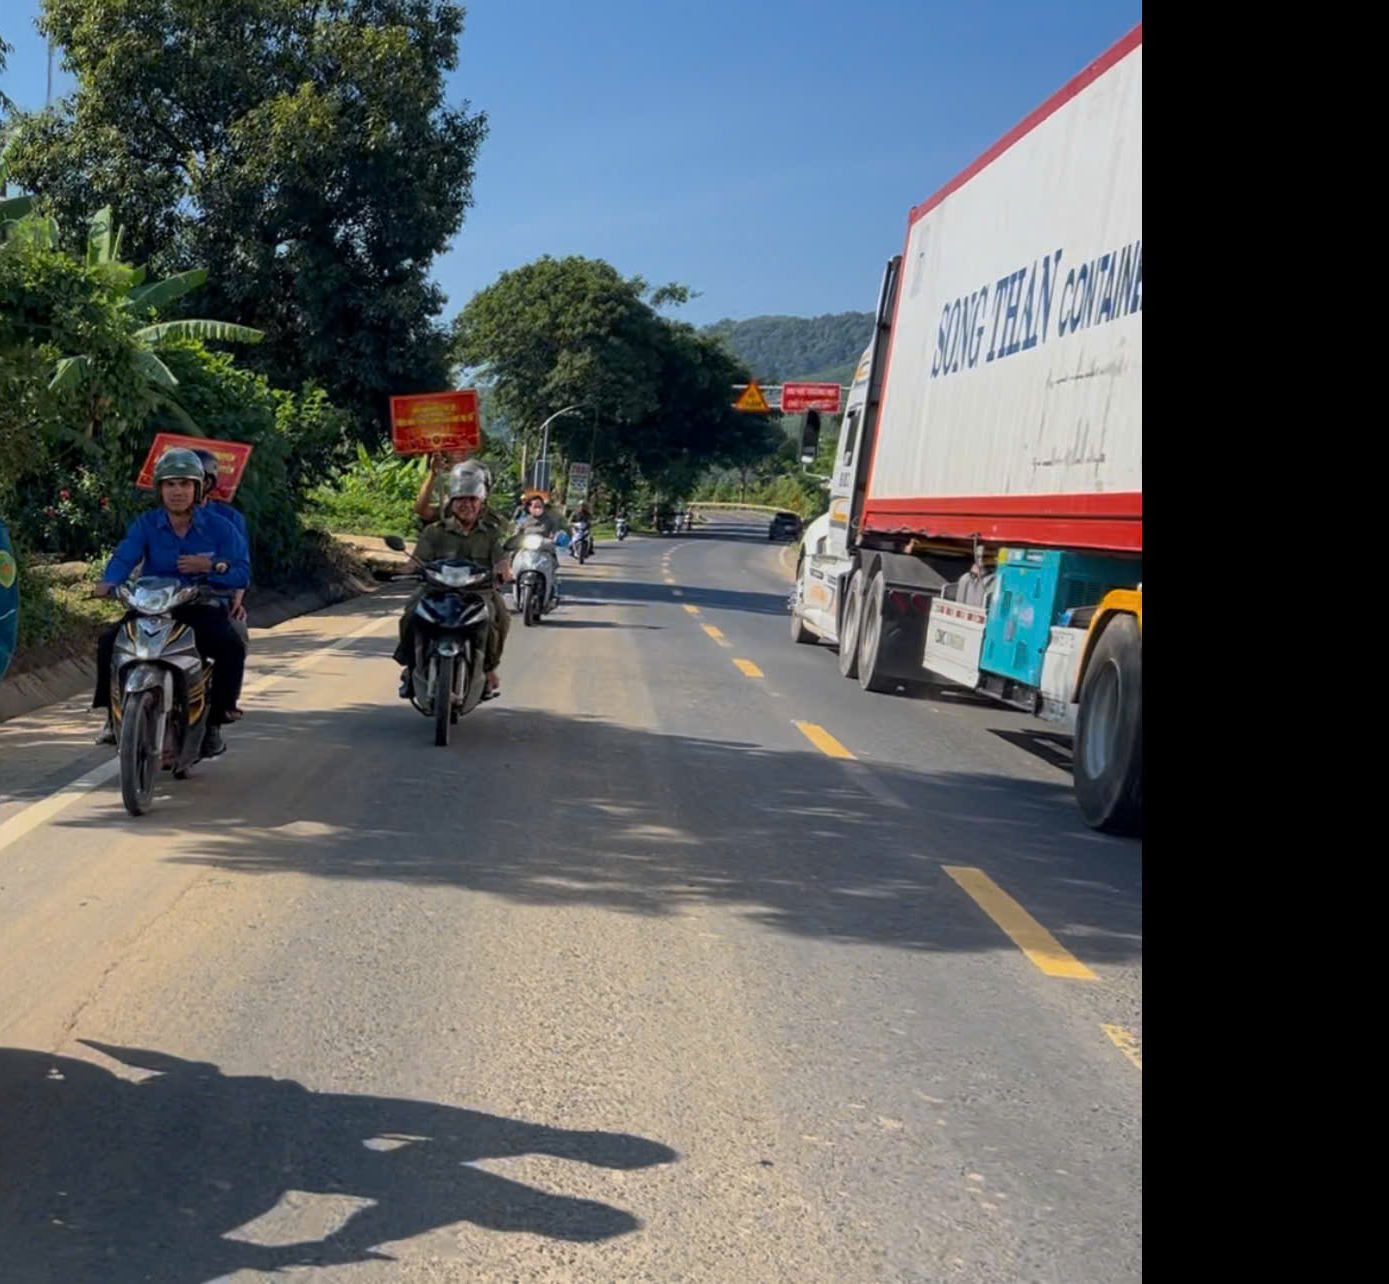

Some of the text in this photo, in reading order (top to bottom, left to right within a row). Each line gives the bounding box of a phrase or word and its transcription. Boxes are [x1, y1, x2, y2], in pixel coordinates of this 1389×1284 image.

[930, 239, 1142, 379] SONG THAN CONTAINE
